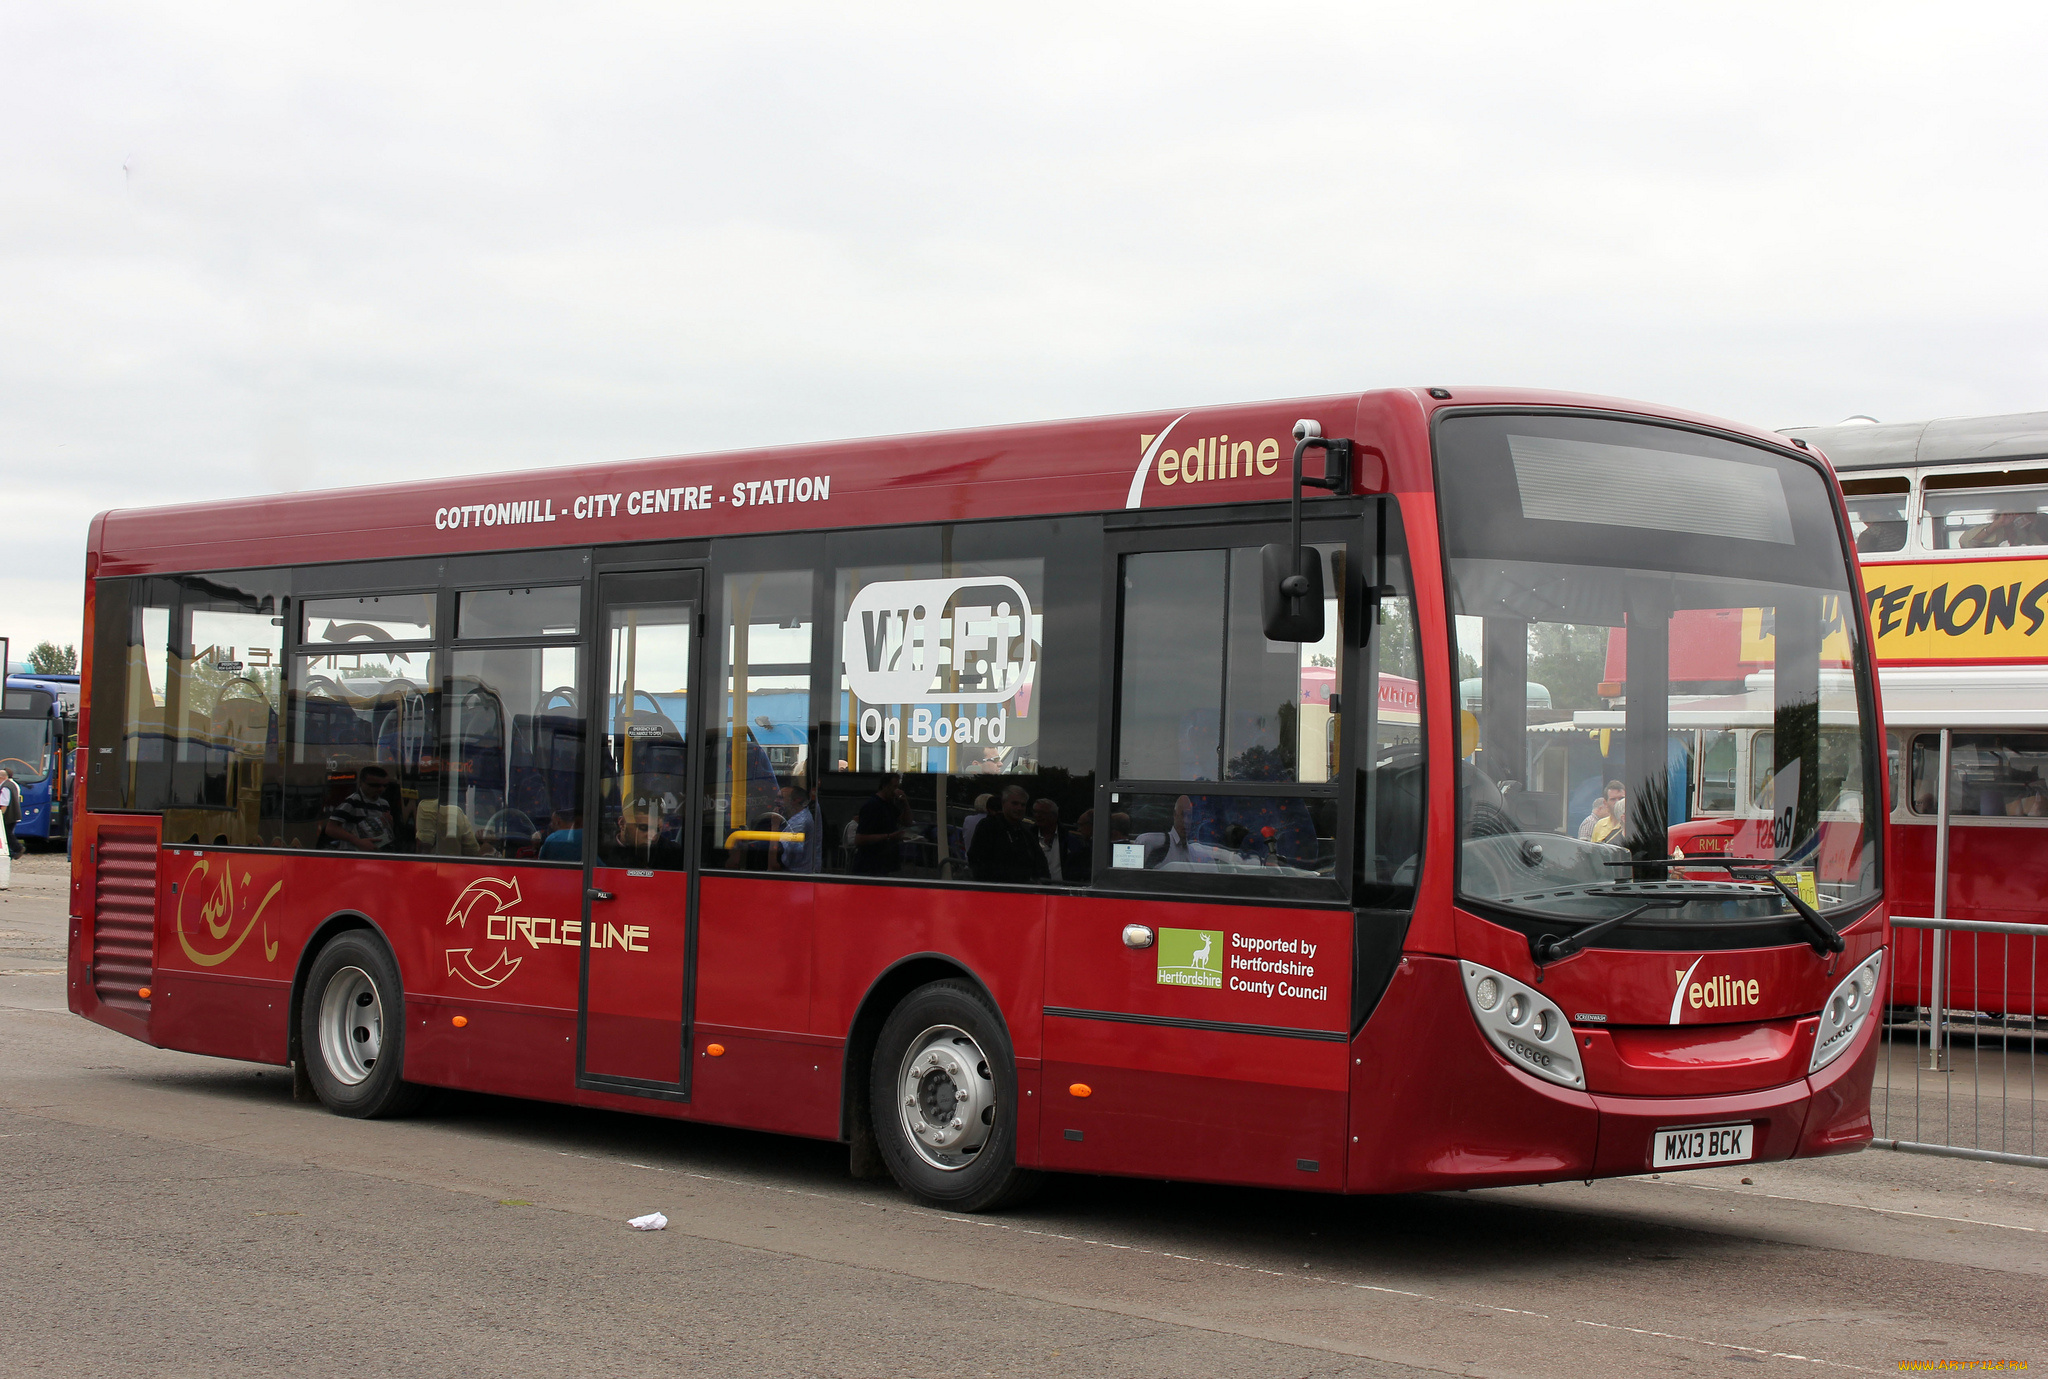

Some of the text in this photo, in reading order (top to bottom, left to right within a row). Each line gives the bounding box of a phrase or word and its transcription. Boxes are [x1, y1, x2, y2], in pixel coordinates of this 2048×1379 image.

[435, 500, 556, 530] COTTONMILL
[573, 493, 622, 520] CITY
[627, 485, 713, 516] CENTRE
[731, 475, 832, 507] STATION
[860, 707, 1007, 744] On Board
[1699, 839, 1721, 851] RML
[487, 915, 650, 952] CIRCLE LINE
[1231, 932, 1317, 958] Supported by
[1158, 970, 1221, 987] Hertfordshire
[1230, 954, 1315, 978] Hertfordshire
[1229, 976, 1328, 1001] County Council
[1665, 1129, 1743, 1161] MX13 BCK
